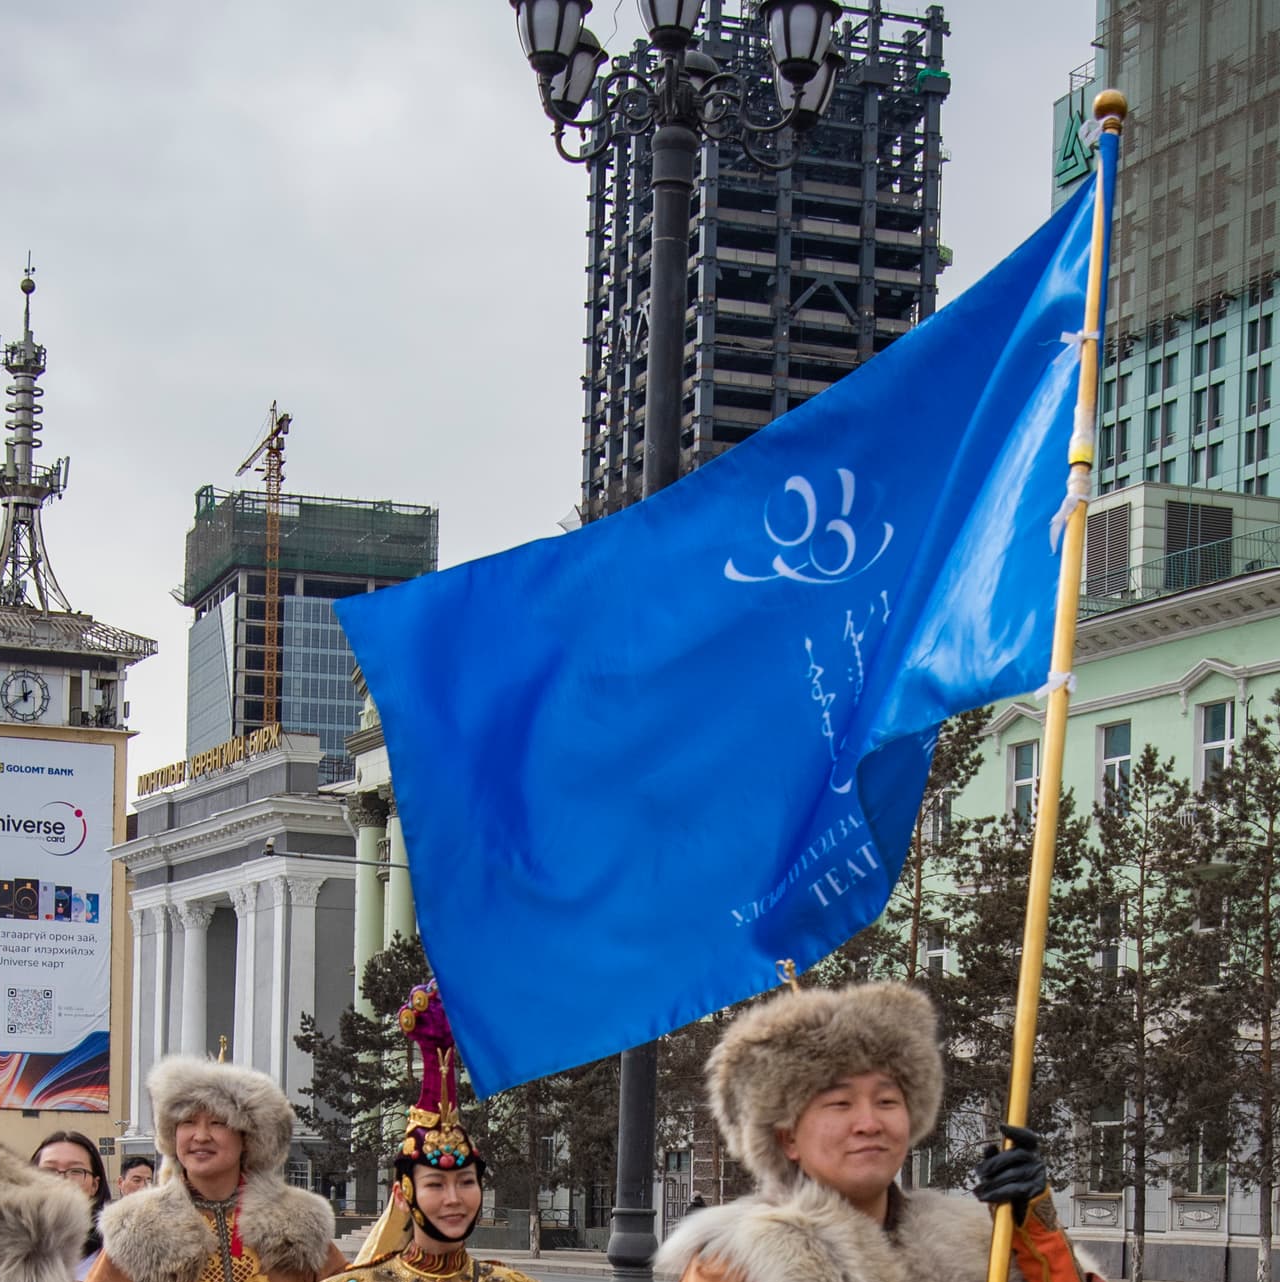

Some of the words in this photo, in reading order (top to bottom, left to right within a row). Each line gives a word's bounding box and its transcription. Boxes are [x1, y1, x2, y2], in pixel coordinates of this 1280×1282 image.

[138, 761, 186, 796] МОНГОЛЫН
[249, 723, 282, 755] БИРЖ
[6, 764, 45, 775] GOLOMT
[47, 767, 74, 777] BANK
[46, 835, 66, 843] card
[808, 840, 880, 908] ТЕАТ
[49, 933, 74, 943] орон
[77, 933, 98, 944] зай,
[34, 946, 95, 956] илэрхийлэх
[41, 960, 65, 970] карт
